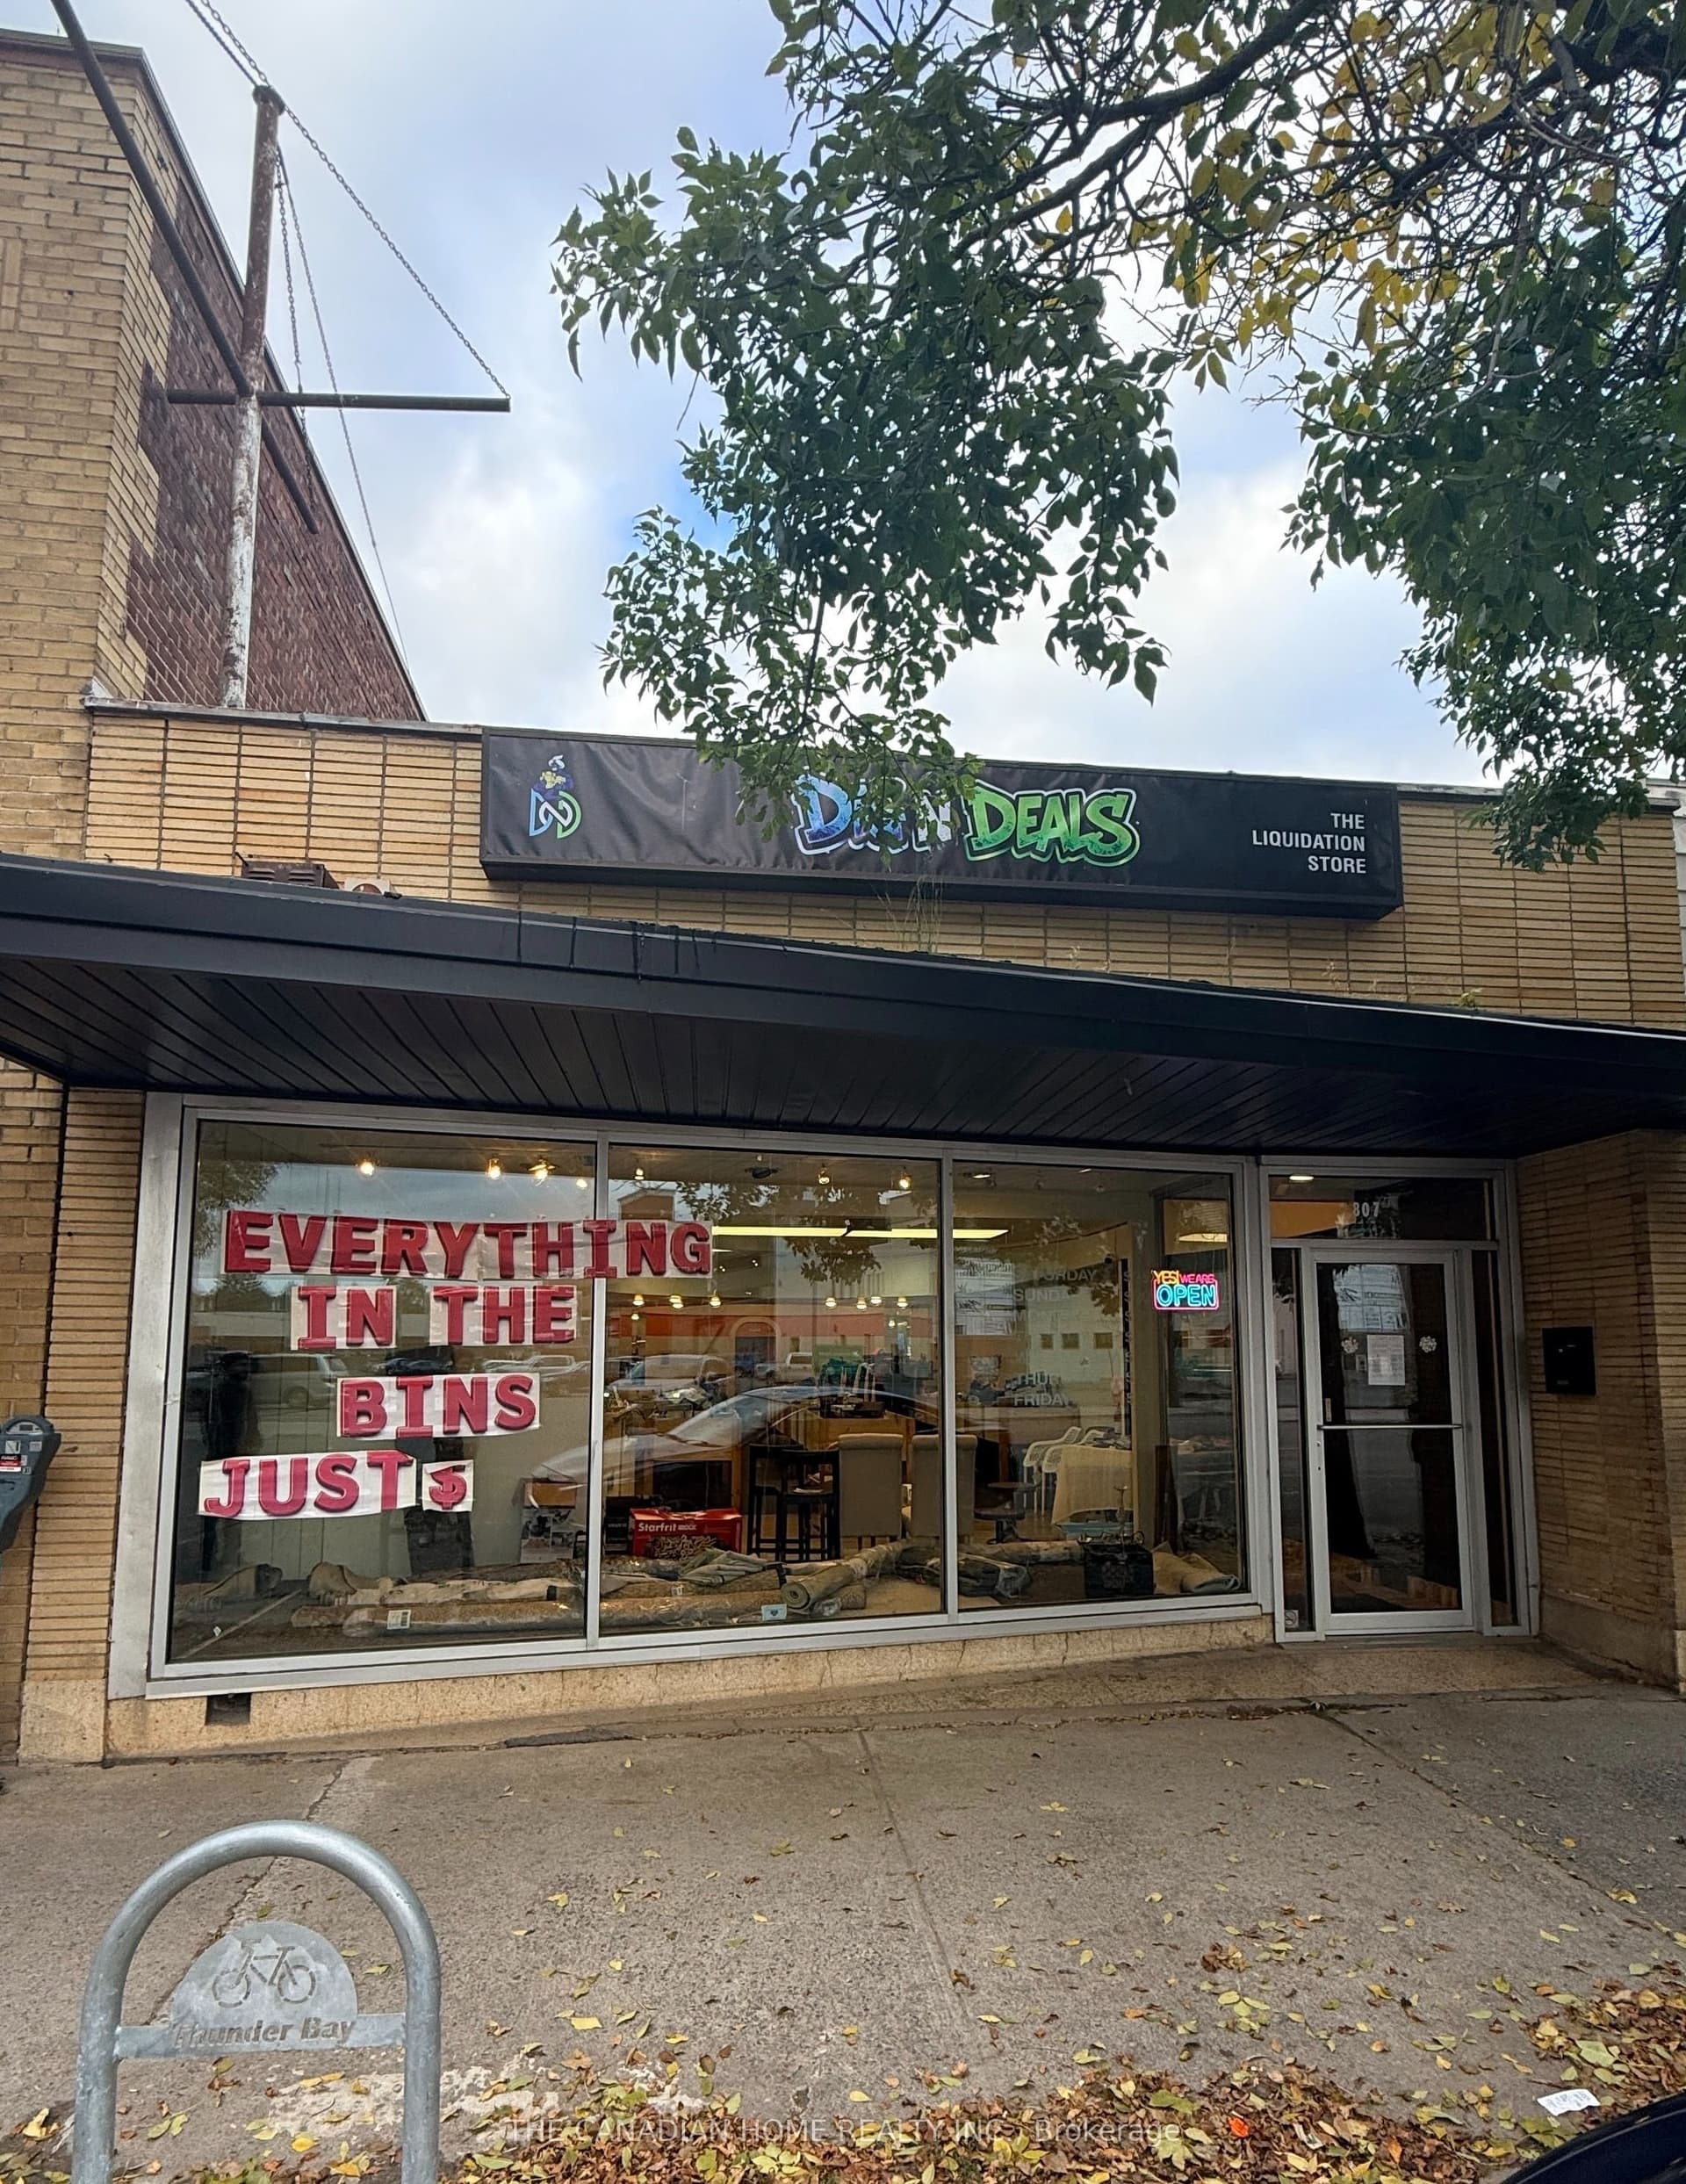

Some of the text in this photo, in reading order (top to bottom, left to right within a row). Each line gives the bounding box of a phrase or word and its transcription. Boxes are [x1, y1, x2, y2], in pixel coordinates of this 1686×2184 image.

[964, 780, 1139, 864] DEALS
[1330, 812, 1365, 830] THE
[1251, 830, 1365, 852] LIQUIDATION
[1308, 855, 1366, 874] STORE
[1353, 1201, 1380, 1218] 807
[226, 1209, 710, 1279] EVERYTHING
[1156, 1284, 1216, 1307] OPEN
[298, 1285, 576, 1351] IN THE
[338, 1374, 537, 1438] BINS
[204, 1449, 414, 1518] JUST
[638, 1522, 676, 1532] Starfrit
[173, 2017, 356, 2048] Thunder Bay
